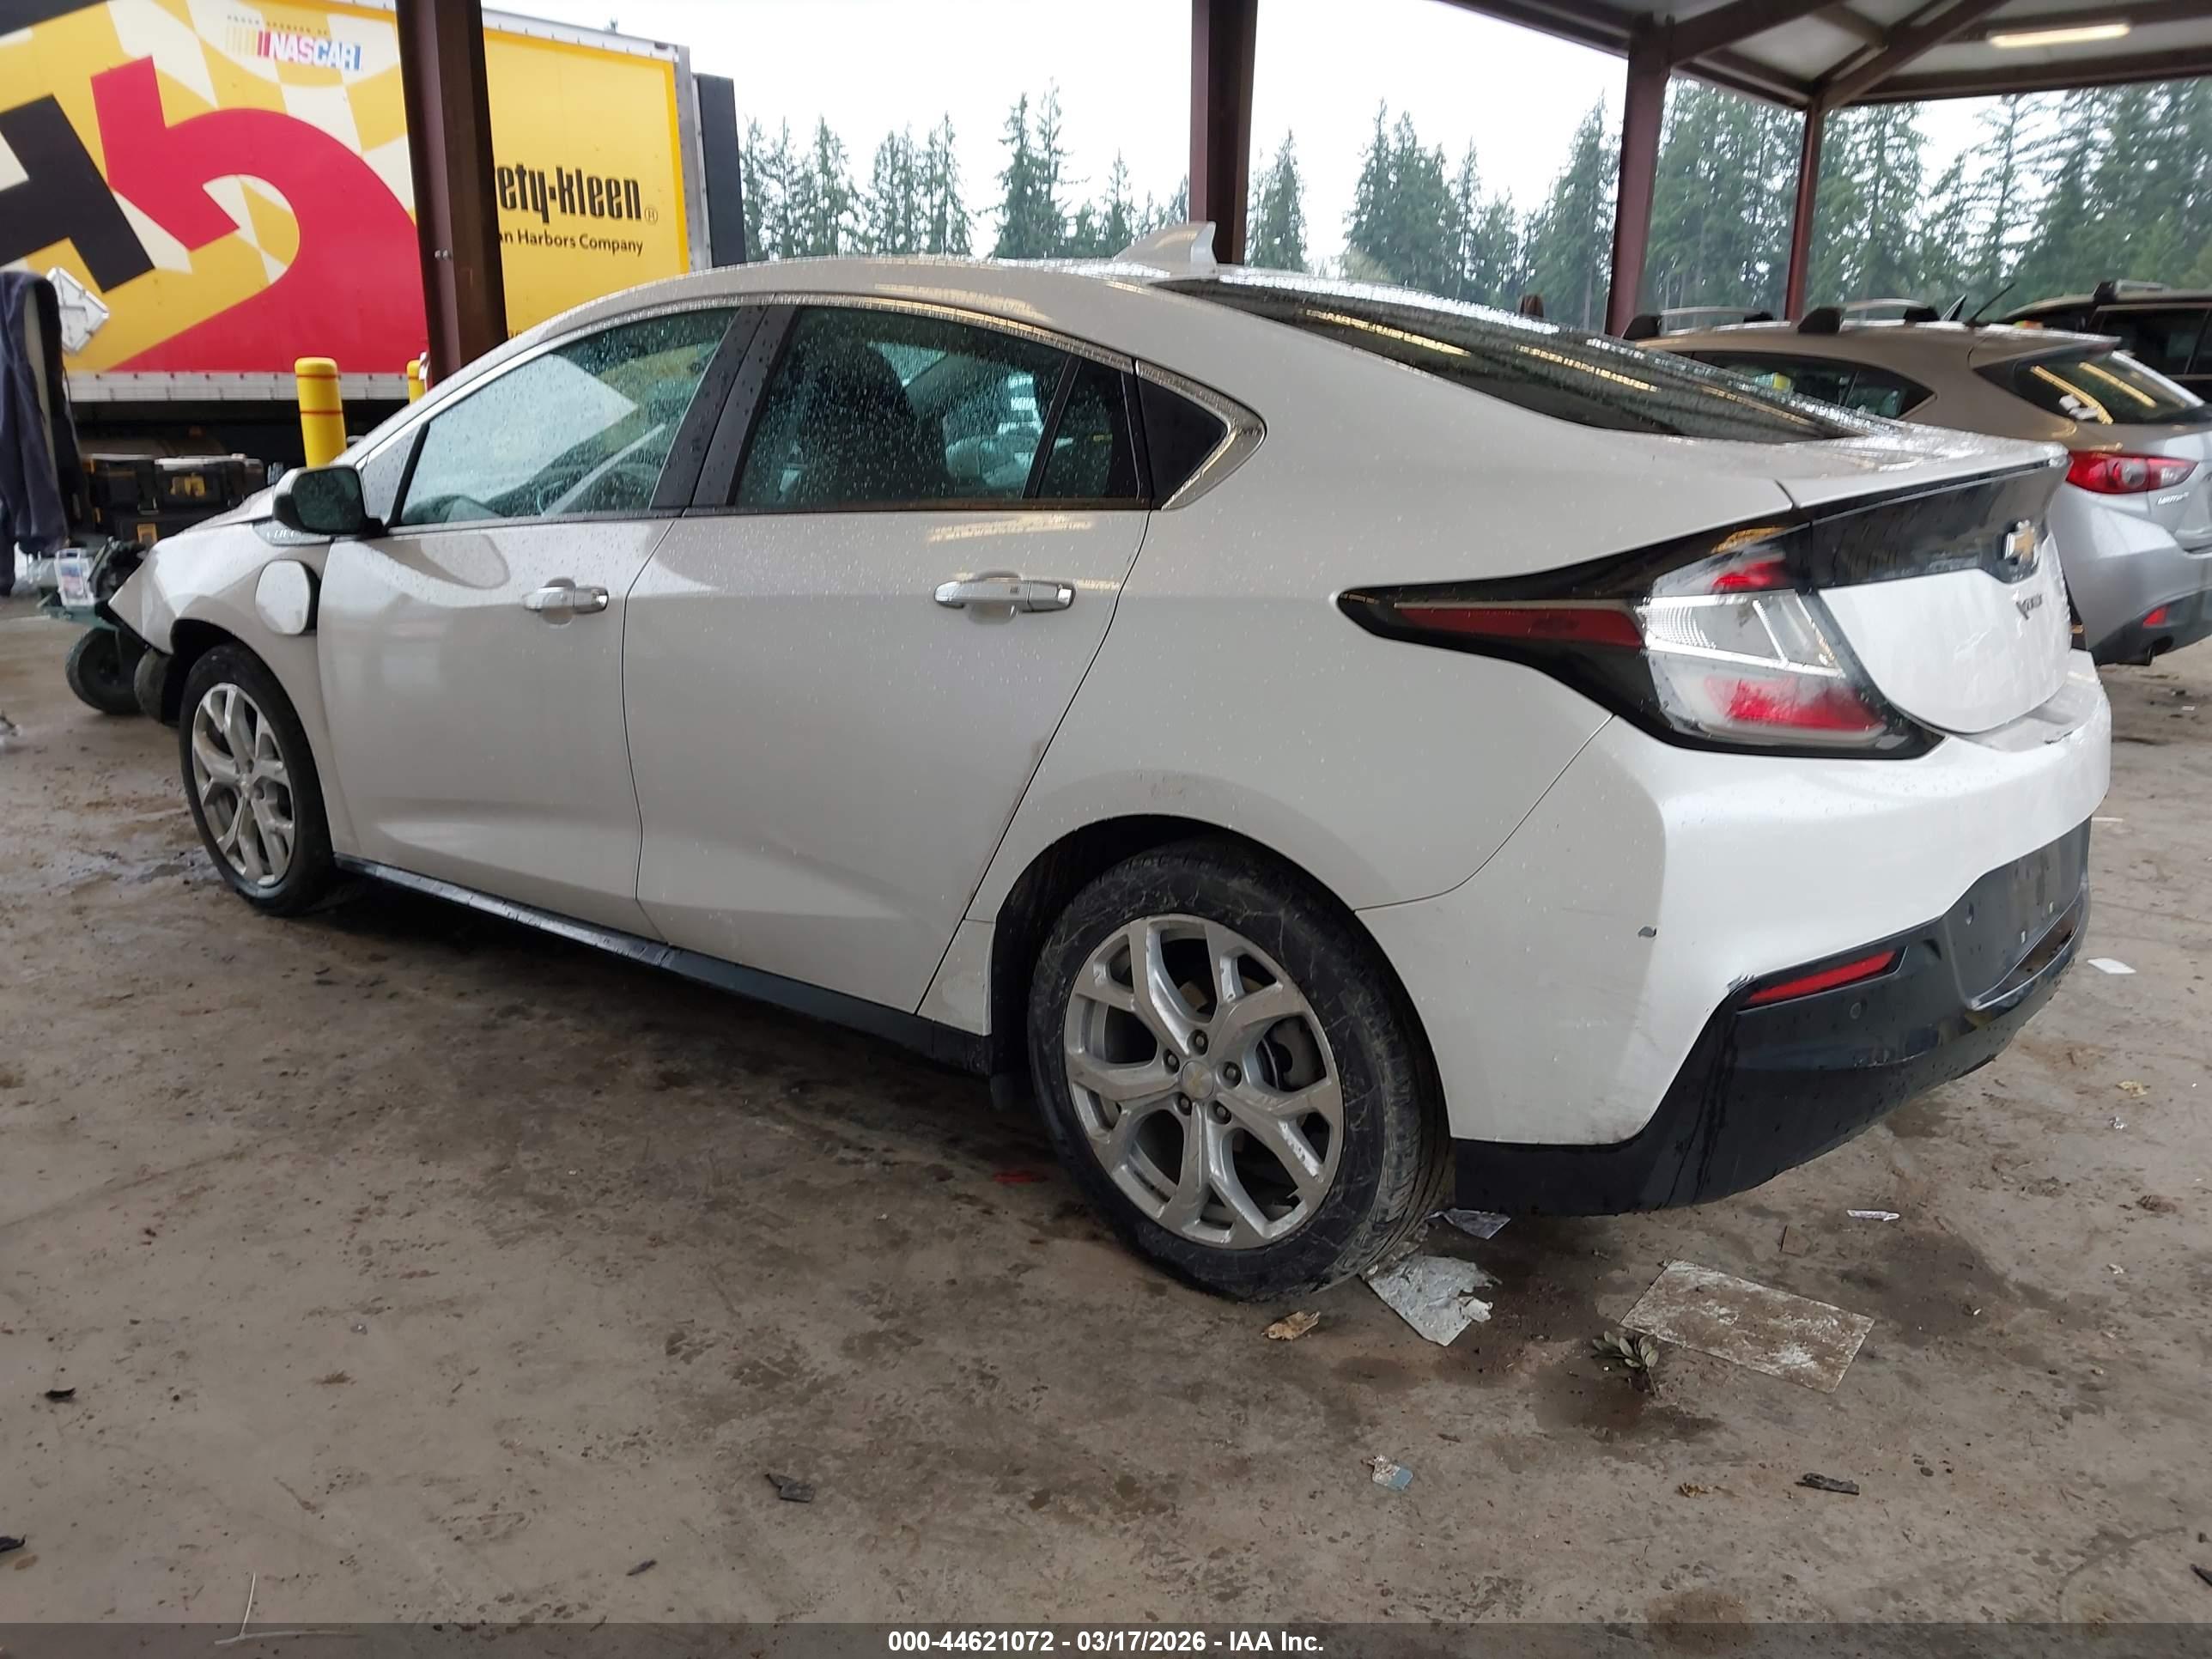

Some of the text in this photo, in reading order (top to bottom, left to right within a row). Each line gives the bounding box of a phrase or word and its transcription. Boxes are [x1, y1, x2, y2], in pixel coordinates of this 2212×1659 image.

[269, 31, 357, 70] NASCAR
[517, 228, 575, 249] Harbors
[579, 233, 643, 257] Company
